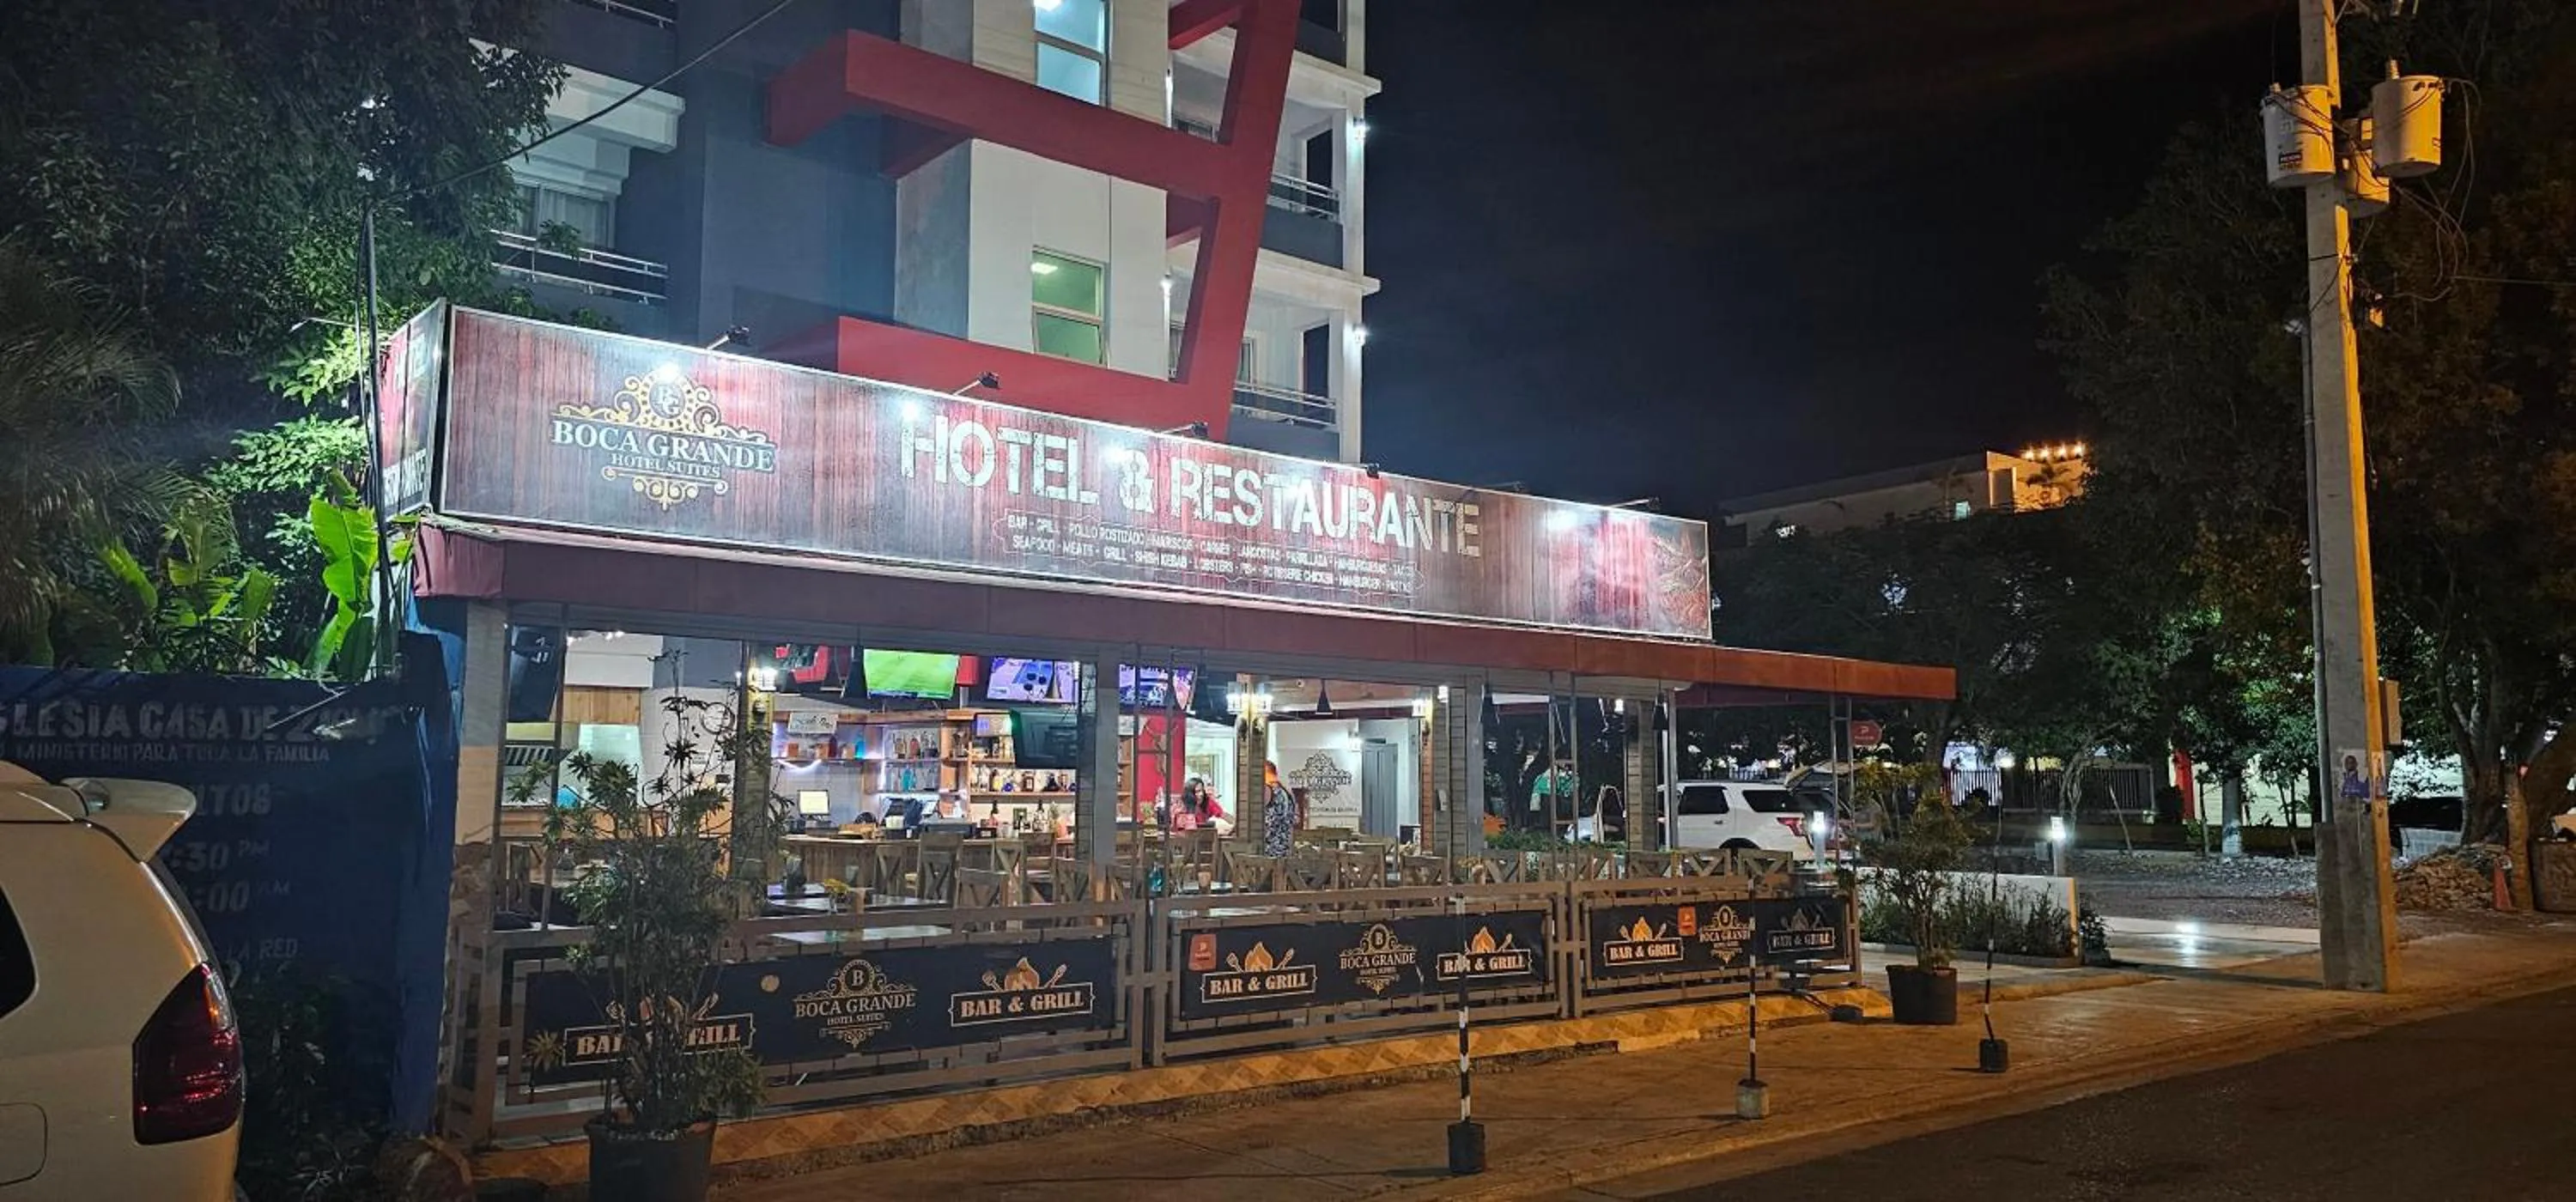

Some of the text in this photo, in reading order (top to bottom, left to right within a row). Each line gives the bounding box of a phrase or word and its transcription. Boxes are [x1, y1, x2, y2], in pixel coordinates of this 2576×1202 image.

[552, 420, 775, 471] BOCA GRANDE
[611, 452, 720, 478] HOTEL SUITES
[901, 414, 1480, 558] HOTEL & RESTAURANTE
[1007, 514, 1028, 529] BAR
[139, 701, 230, 740] CASA
[133, 743, 179, 762] PARA
[265, 744, 331, 762] FAMILIA
[197, 782, 272, 817] LTOS
[1371, 952, 1416, 966] GRANDE
[1474, 957, 1485, 971] &
[1490, 953, 1526, 969] GRILL
[851, 968, 864, 986] B
[1210, 973, 1308, 995] BAR & GRILL
[795, 993, 916, 1017] BOCA GRANDE
[960, 991, 1084, 1017] BAR & GRILL
